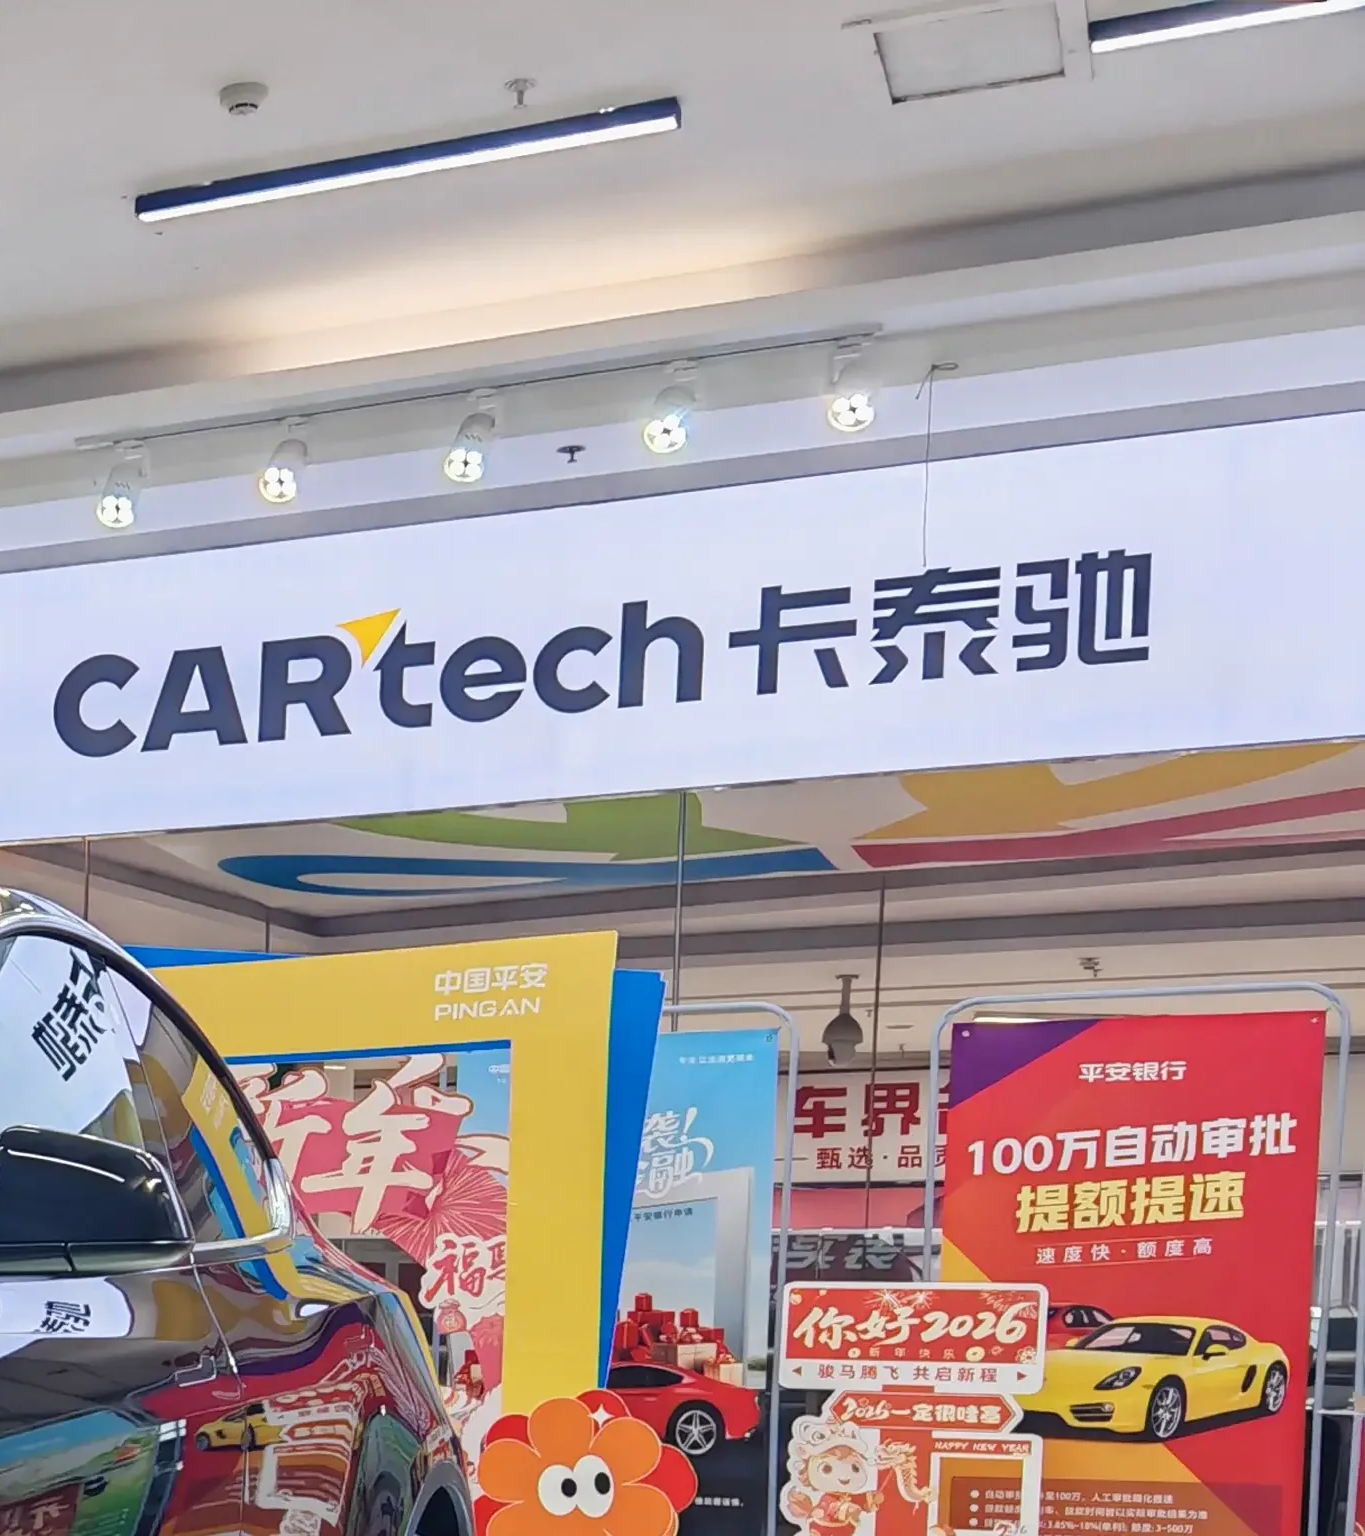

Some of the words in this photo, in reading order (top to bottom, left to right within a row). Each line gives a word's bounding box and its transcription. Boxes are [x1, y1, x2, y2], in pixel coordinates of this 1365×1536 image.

[52, 600, 704, 759] CARtech
[728, 549, 1154, 697] 卡泰驰
[434, 963, 548, 995] 中国平安
[1078, 1061, 1187, 1083] 平安银行
[967, 1112, 1298, 1176] 100万自动审批
[1015, 1170, 1246, 1234] 提额提速
[793, 1301, 1038, 1351] 你好2026
[818, 1364, 900, 1380] 骏马腾飞
[912, 1365, 998, 1383] 共启新程
[934, 1441, 968, 1451] HAPPY
[973, 1441, 998, 1451] NEW
[1002, 1442, 1030, 1453] YEAR
